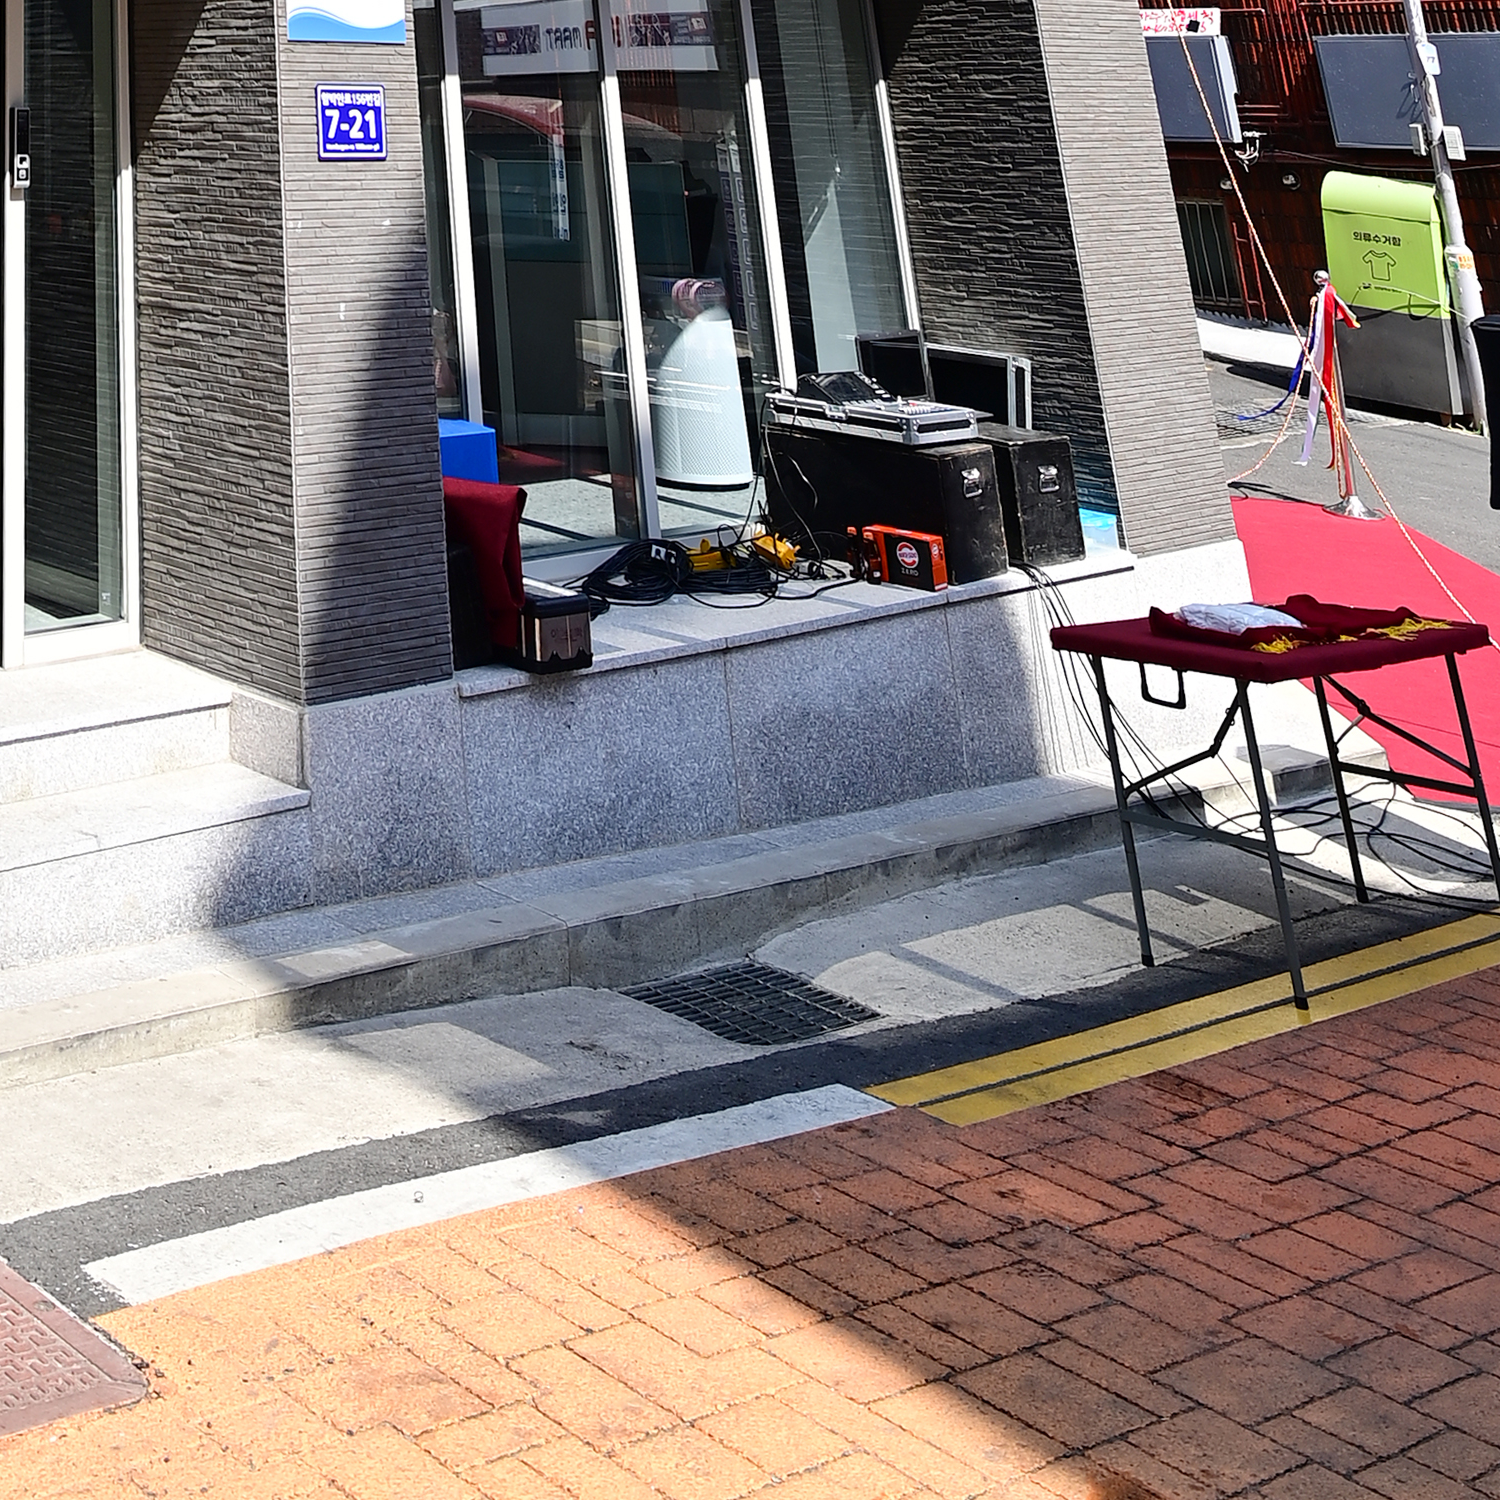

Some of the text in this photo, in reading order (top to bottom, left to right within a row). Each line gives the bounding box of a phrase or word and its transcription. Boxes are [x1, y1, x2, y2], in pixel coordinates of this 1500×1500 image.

[325, 108, 377, 139] 7-21
[1353, 231, 1402, 247] 의류수거함
[901, 567, 919, 576] ZERO
